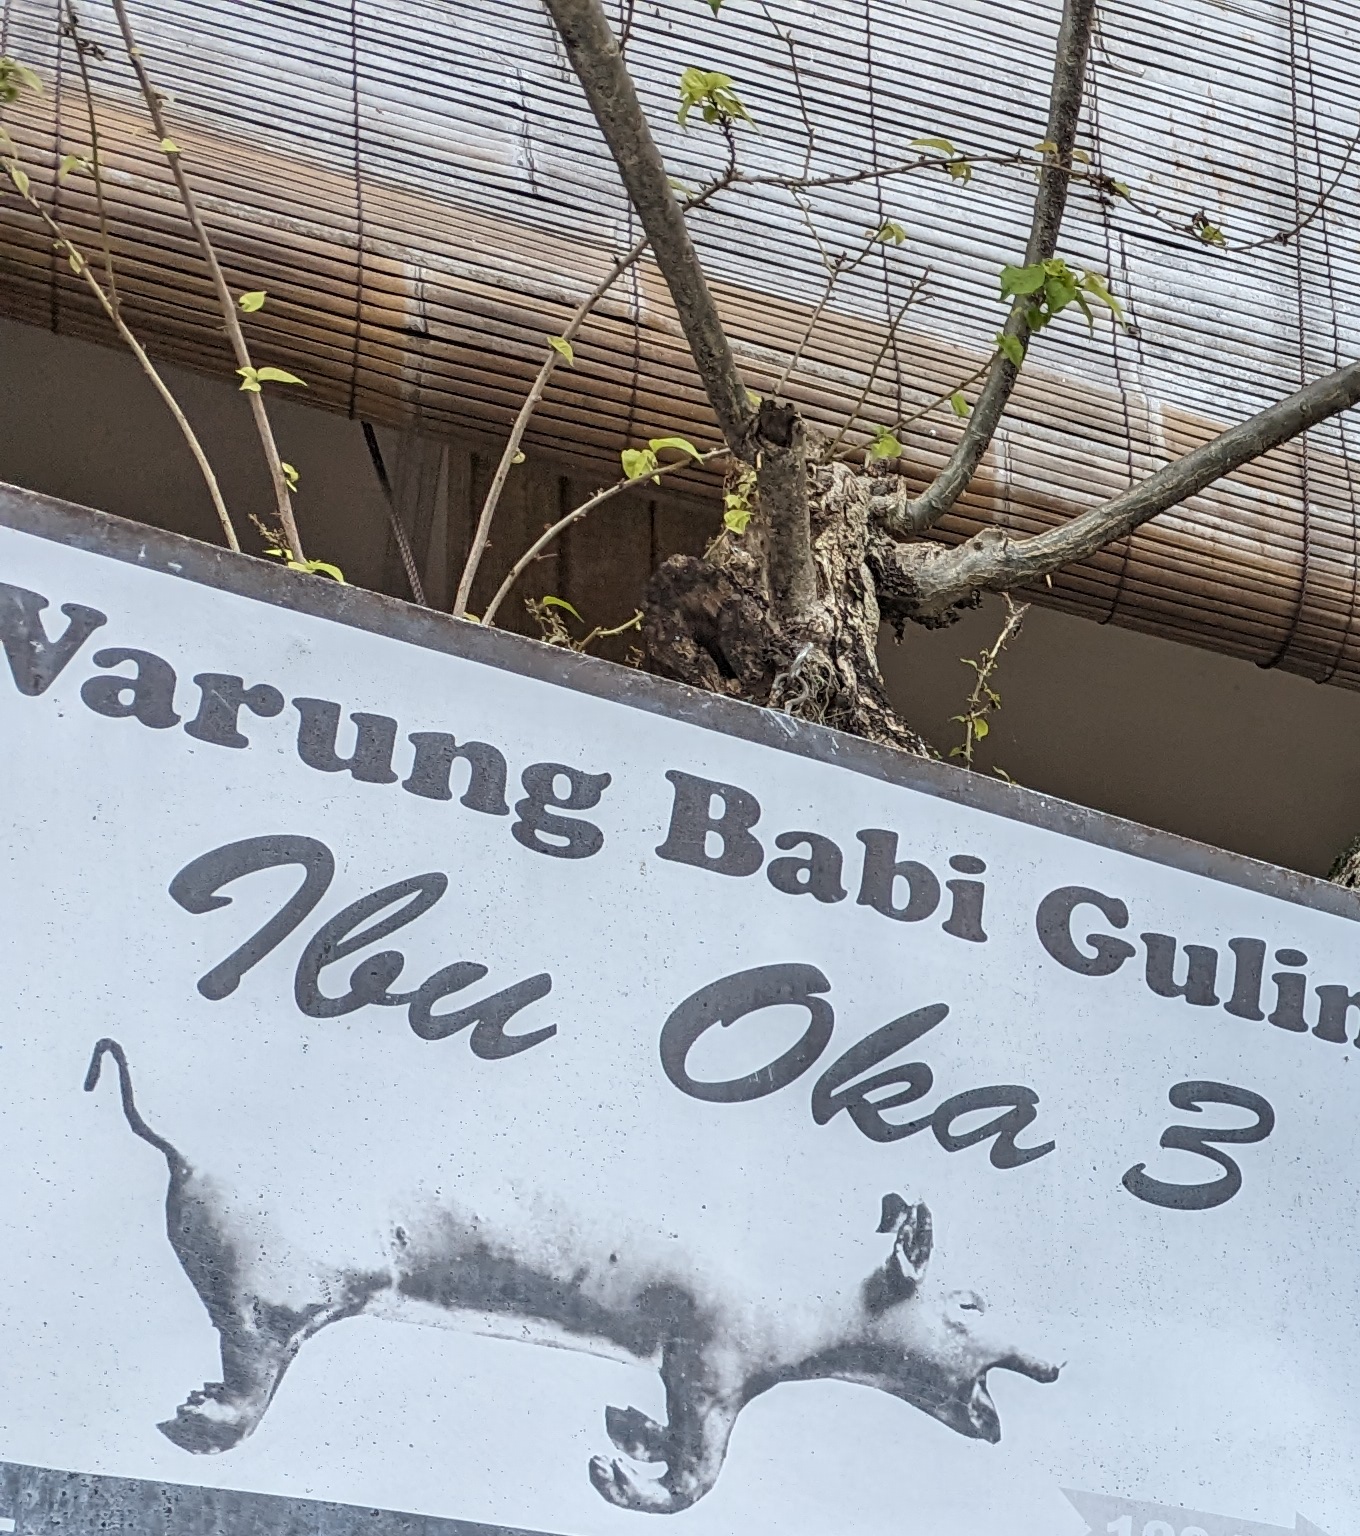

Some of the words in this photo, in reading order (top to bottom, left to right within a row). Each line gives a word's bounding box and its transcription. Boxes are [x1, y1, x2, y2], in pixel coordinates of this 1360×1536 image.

[654, 769, 988, 943] Babi
[169, 834, 558, 1059] Ibu
[660, 962, 1056, 1170] Oka
[1121, 1080, 1275, 1210] 3
